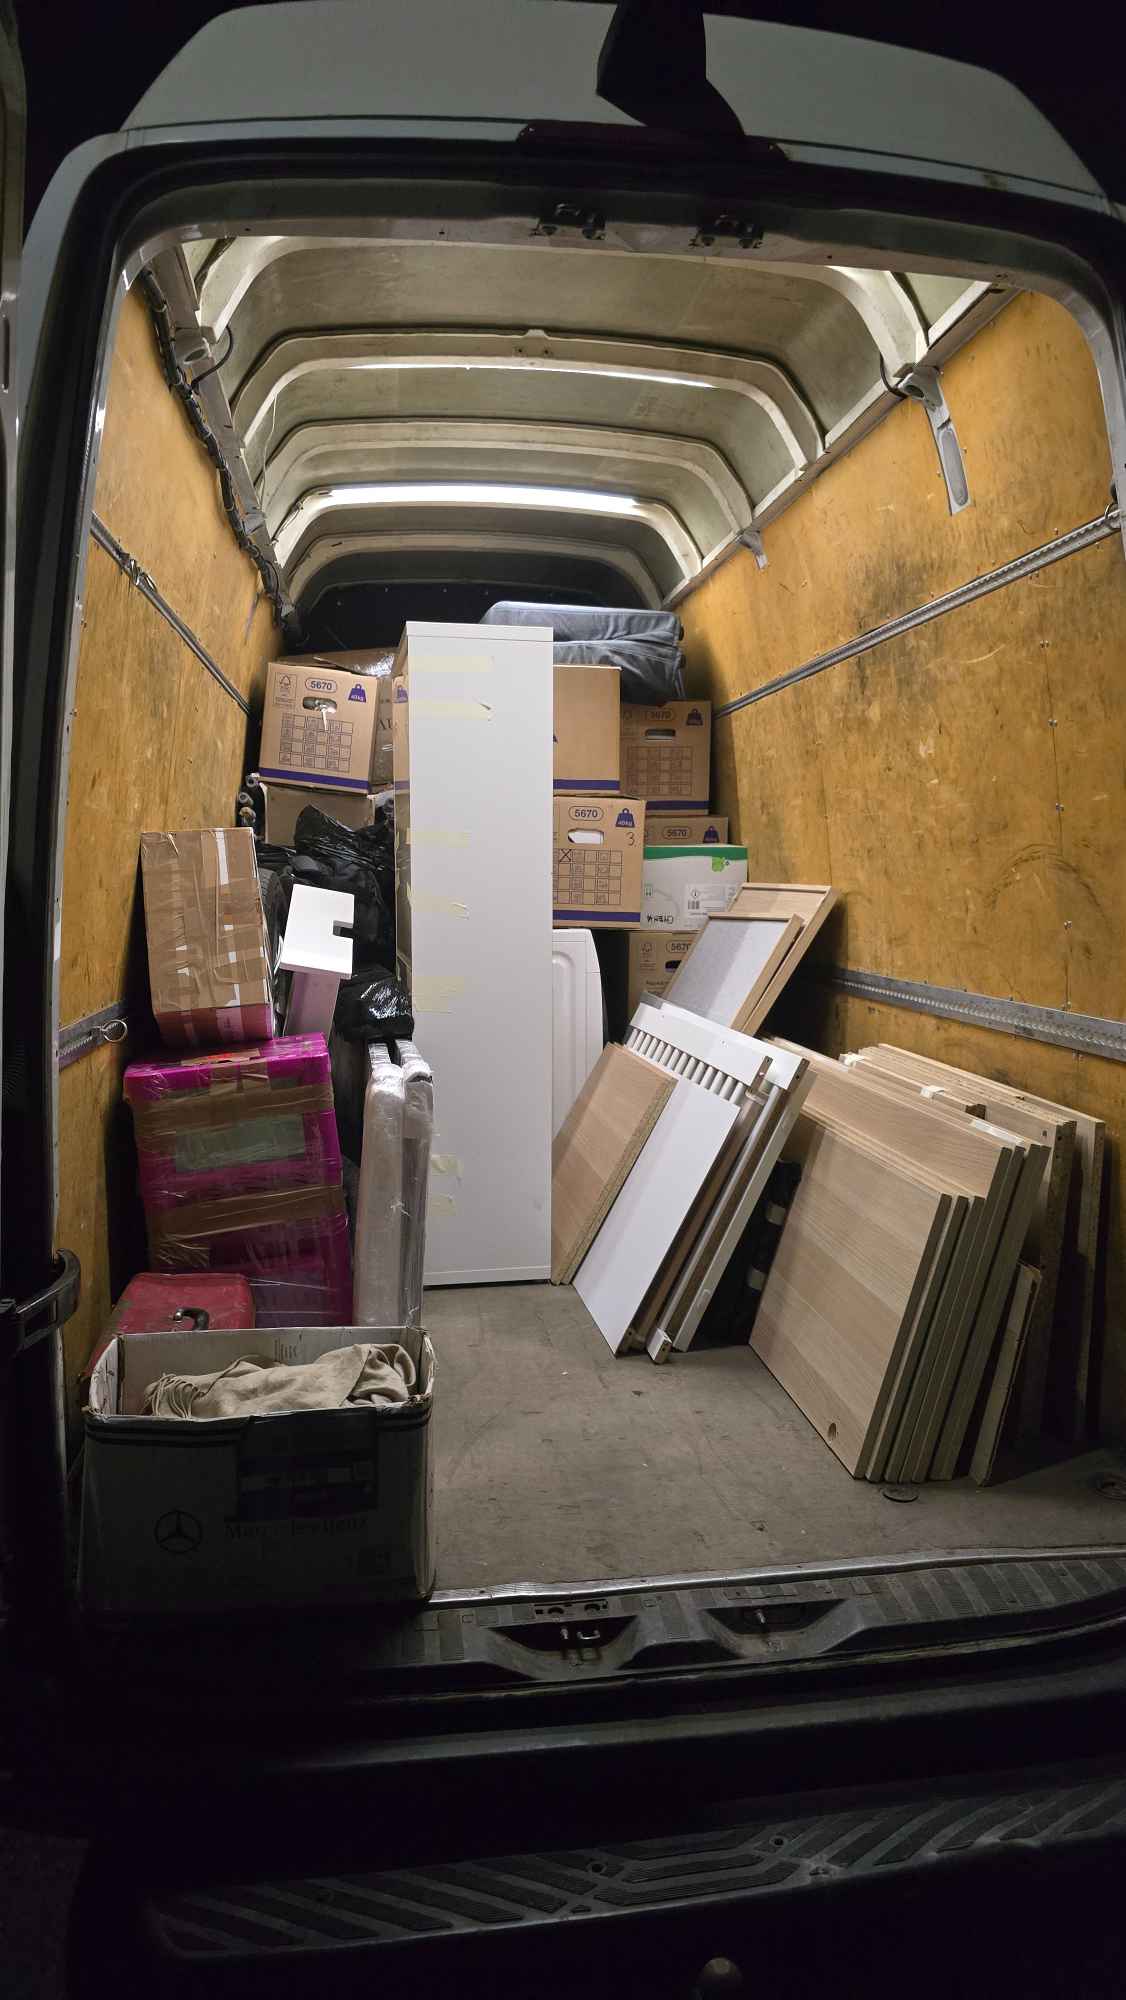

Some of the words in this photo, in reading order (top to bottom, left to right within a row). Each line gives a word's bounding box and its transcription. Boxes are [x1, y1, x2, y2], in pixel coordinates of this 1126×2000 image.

[310, 680, 333, 691] 5670
[574, 808, 598, 818] 5670
[666, 829, 687, 838] 5670
